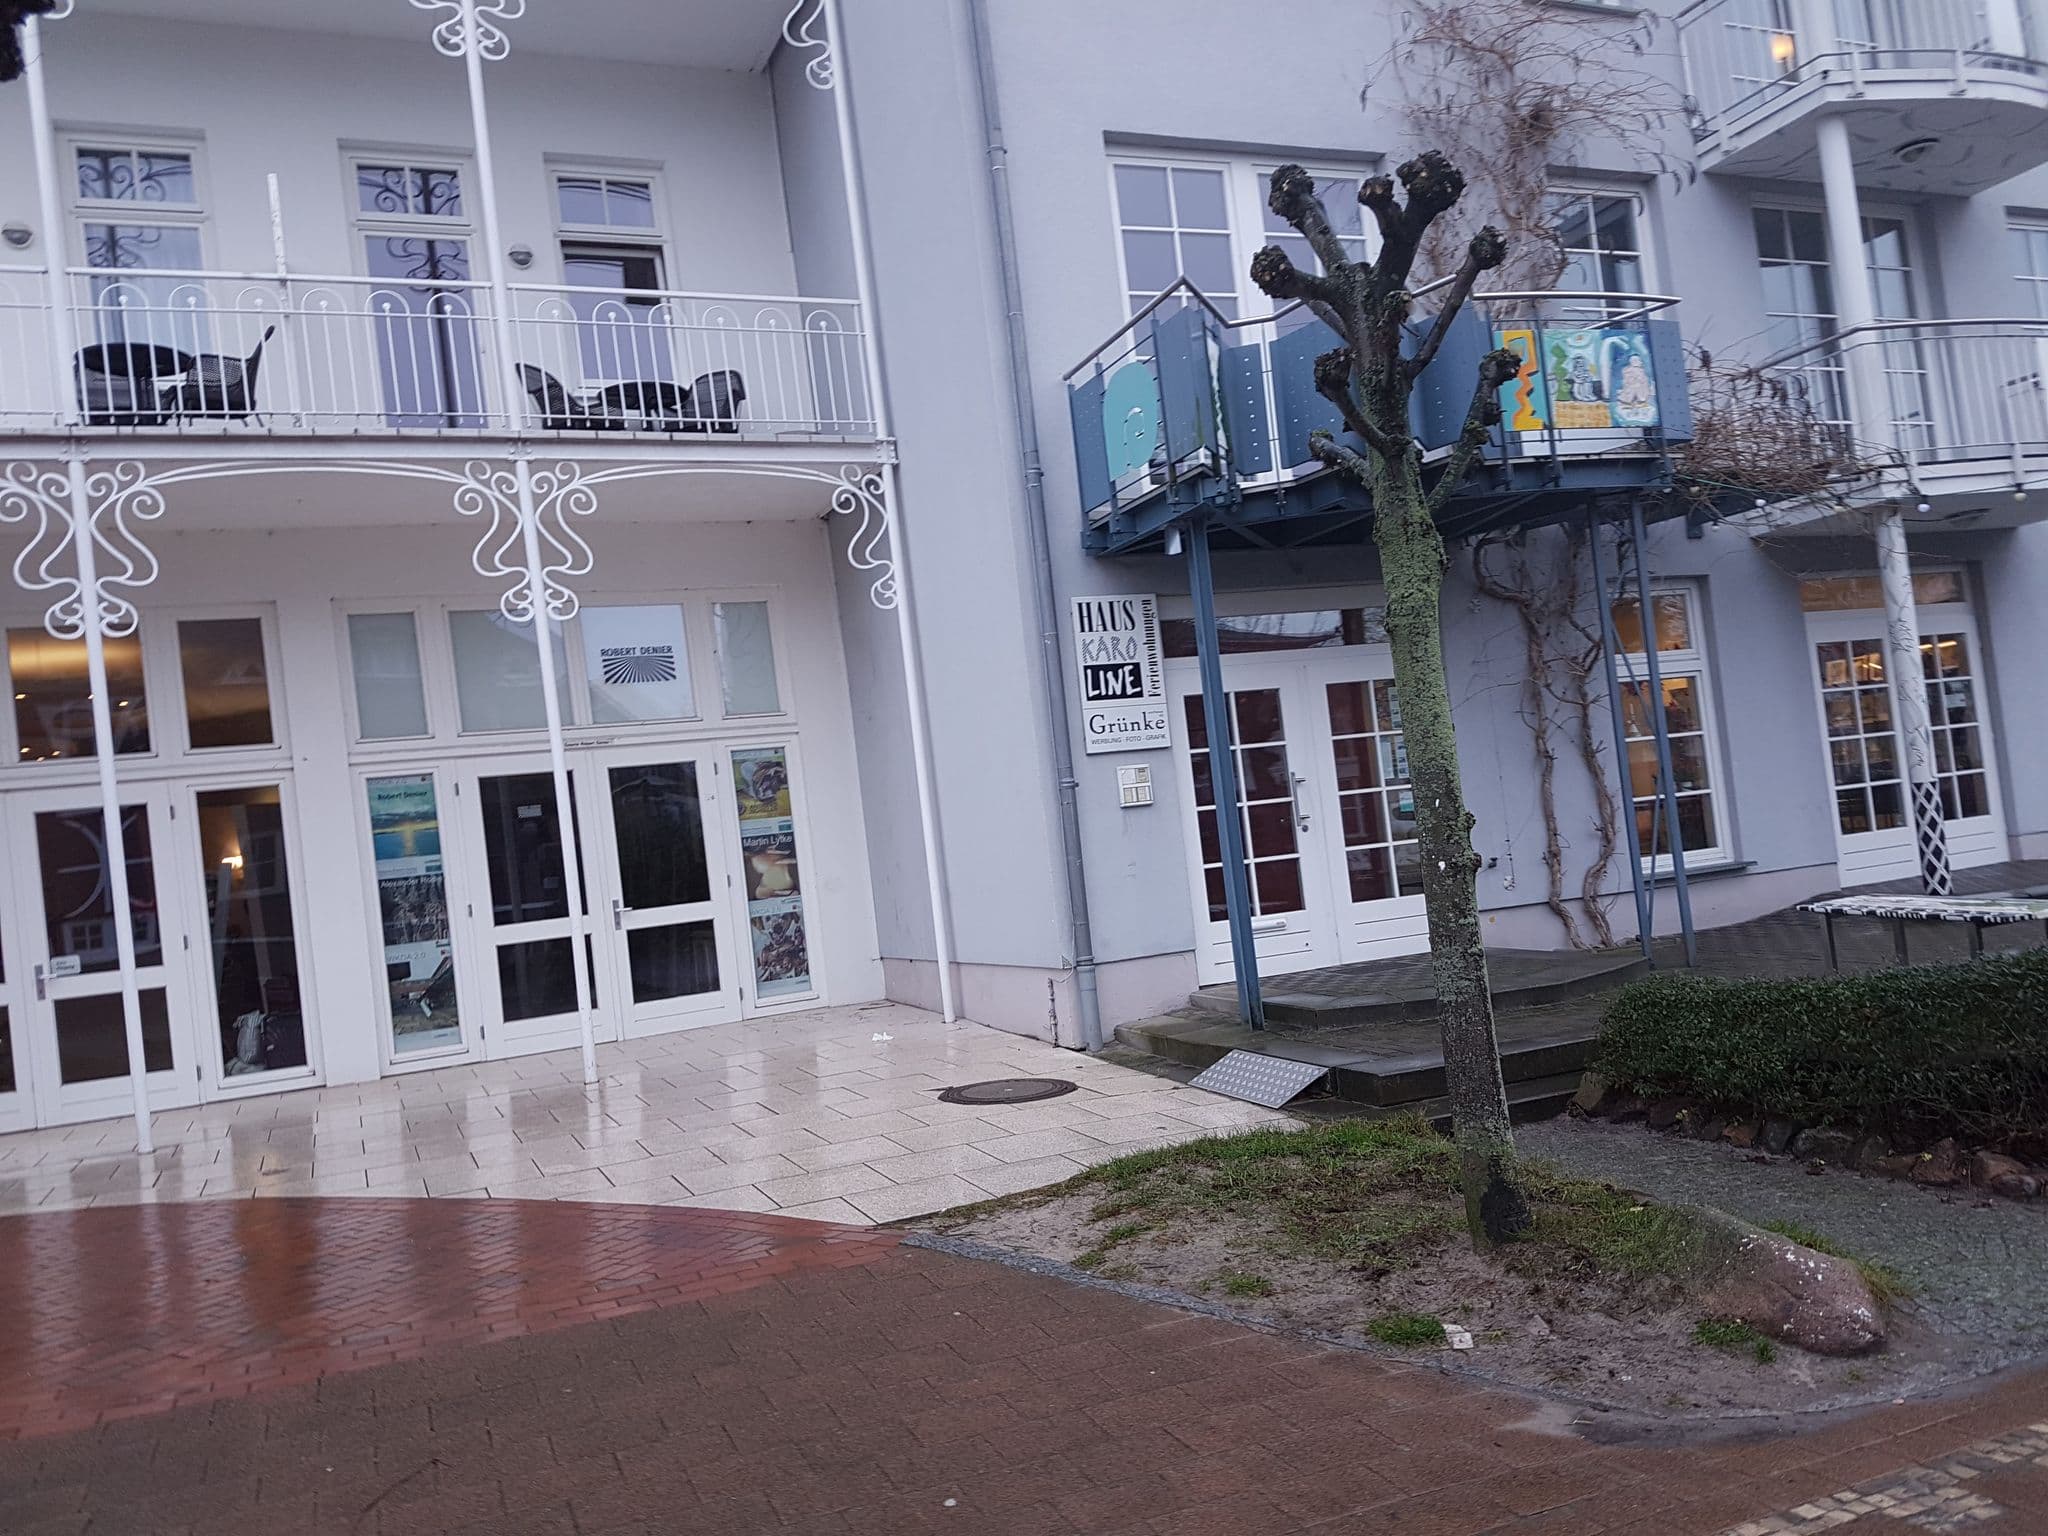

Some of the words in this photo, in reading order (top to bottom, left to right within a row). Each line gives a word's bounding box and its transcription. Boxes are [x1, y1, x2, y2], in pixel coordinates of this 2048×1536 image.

[1077, 600, 1136, 632] HAUS
[600, 647, 637, 657] ROBERT
[640, 645, 674, 655] DENIER
[1082, 636, 1138, 664] KARO
[1141, 599, 1161, 697] Ferienwohnungen
[1086, 665, 1142, 697] LINE
[1089, 711, 1165, 735] Grünke
[1091, 737, 1122, 745] WERBUNG
